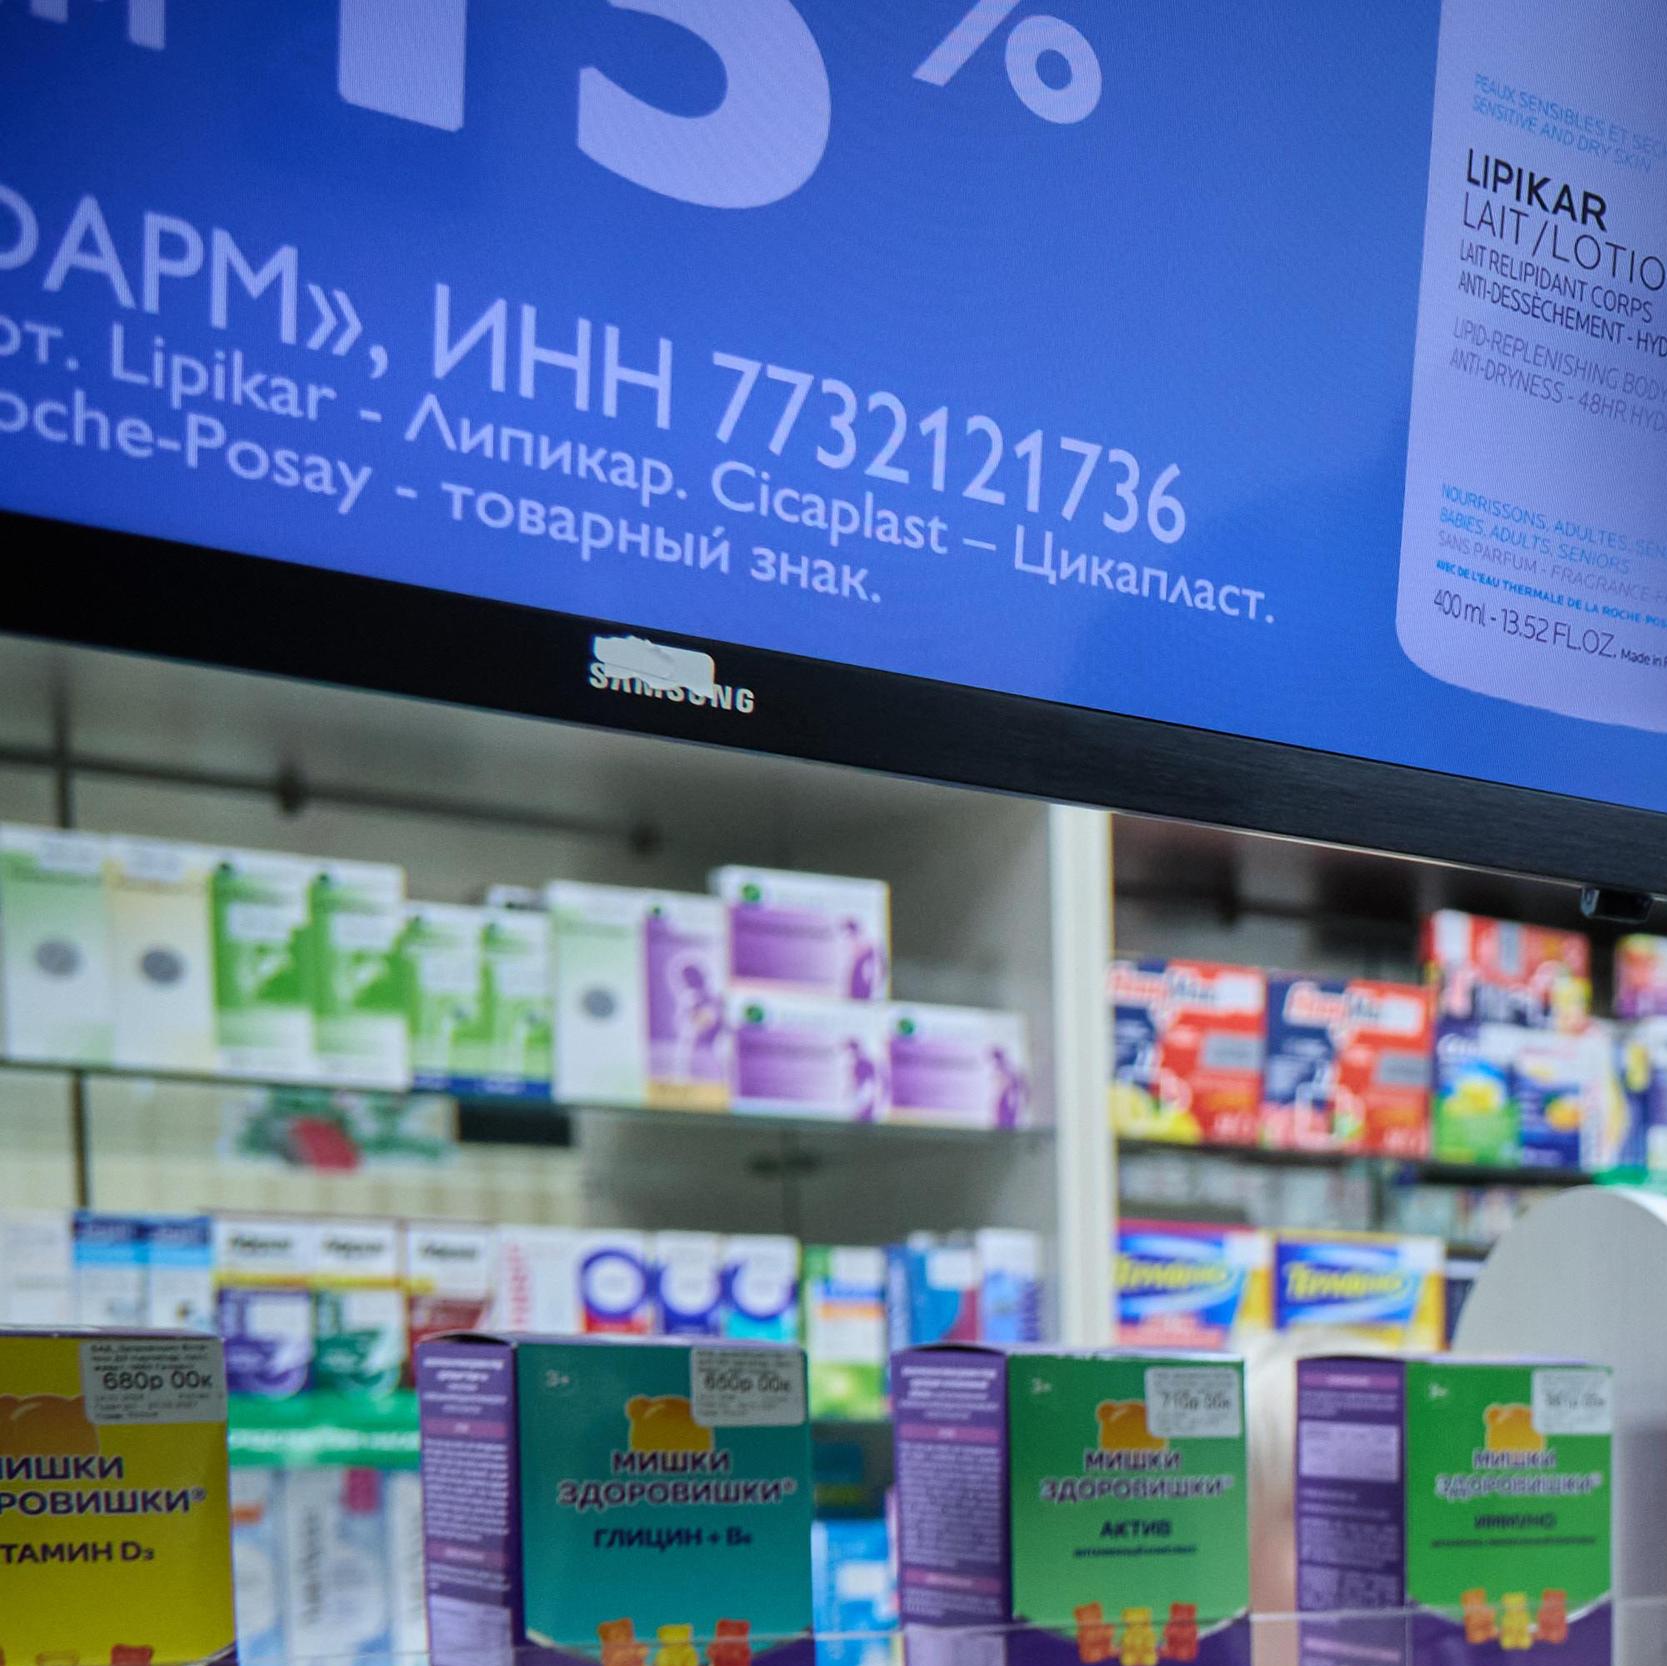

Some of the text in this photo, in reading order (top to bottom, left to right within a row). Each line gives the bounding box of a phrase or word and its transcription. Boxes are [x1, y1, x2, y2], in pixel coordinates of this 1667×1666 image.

[1466, 147, 1608, 232] LIPIKAR
[1489, 250, 1588, 303] RELIPIDANT
[1591, 285, 1653, 324] CORPS
[432, 282, 673, 430] ИНН
[711, 350, 1188, 544] 7732121736
[111, 322, 1276, 624] Lipikar Липикар. Cicaplast Цикапласт.
[441, 480, 731, 575] товарный
[750, 544, 881, 604] знак.
[1432, 588, 1461, 619] 400
[1464, 602, 1486, 628] ml
[1500, 608, 1550, 645] 13.52
[1502, 579, 1564, 606] THERMALE
[0, 1455, 124, 1480] ИШКИ
[611, 1449, 732, 1474] МИШКИ
[594, 1527, 701, 1551] ГЛИЦИН
